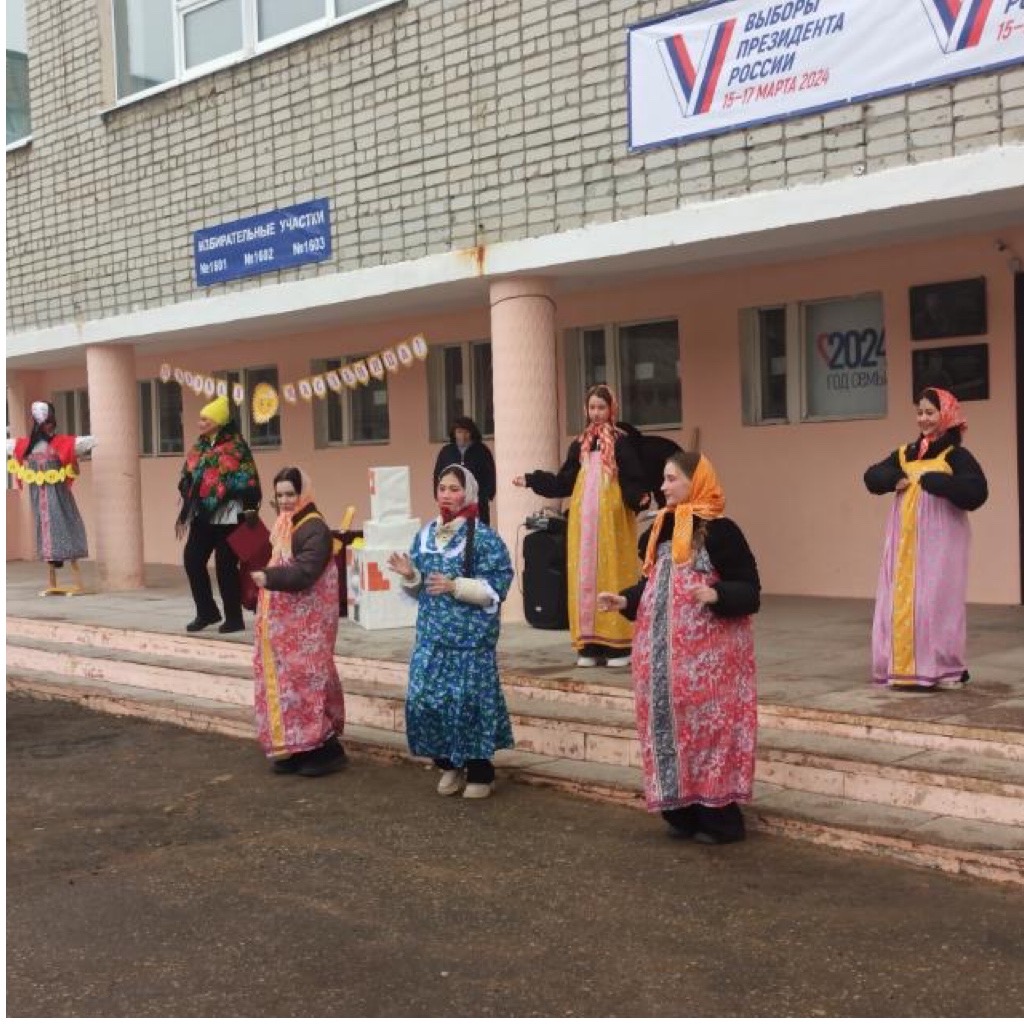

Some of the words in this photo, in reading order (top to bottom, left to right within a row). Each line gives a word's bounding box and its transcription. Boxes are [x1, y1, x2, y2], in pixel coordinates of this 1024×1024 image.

[744, 0, 820, 32] ВЫБОРЫ
[736, 12, 845, 59] ПРЕЗИДЕНТА
[728, 51, 796, 86] РОССИИ
[757, 77, 796, 98] МАРТА
[800, 69, 830, 90] 2024
[198, 222, 275, 252] ИЗБИРАТЕЛЬНЫЕ
[279, 209, 324, 233] УЧАСТКИ
